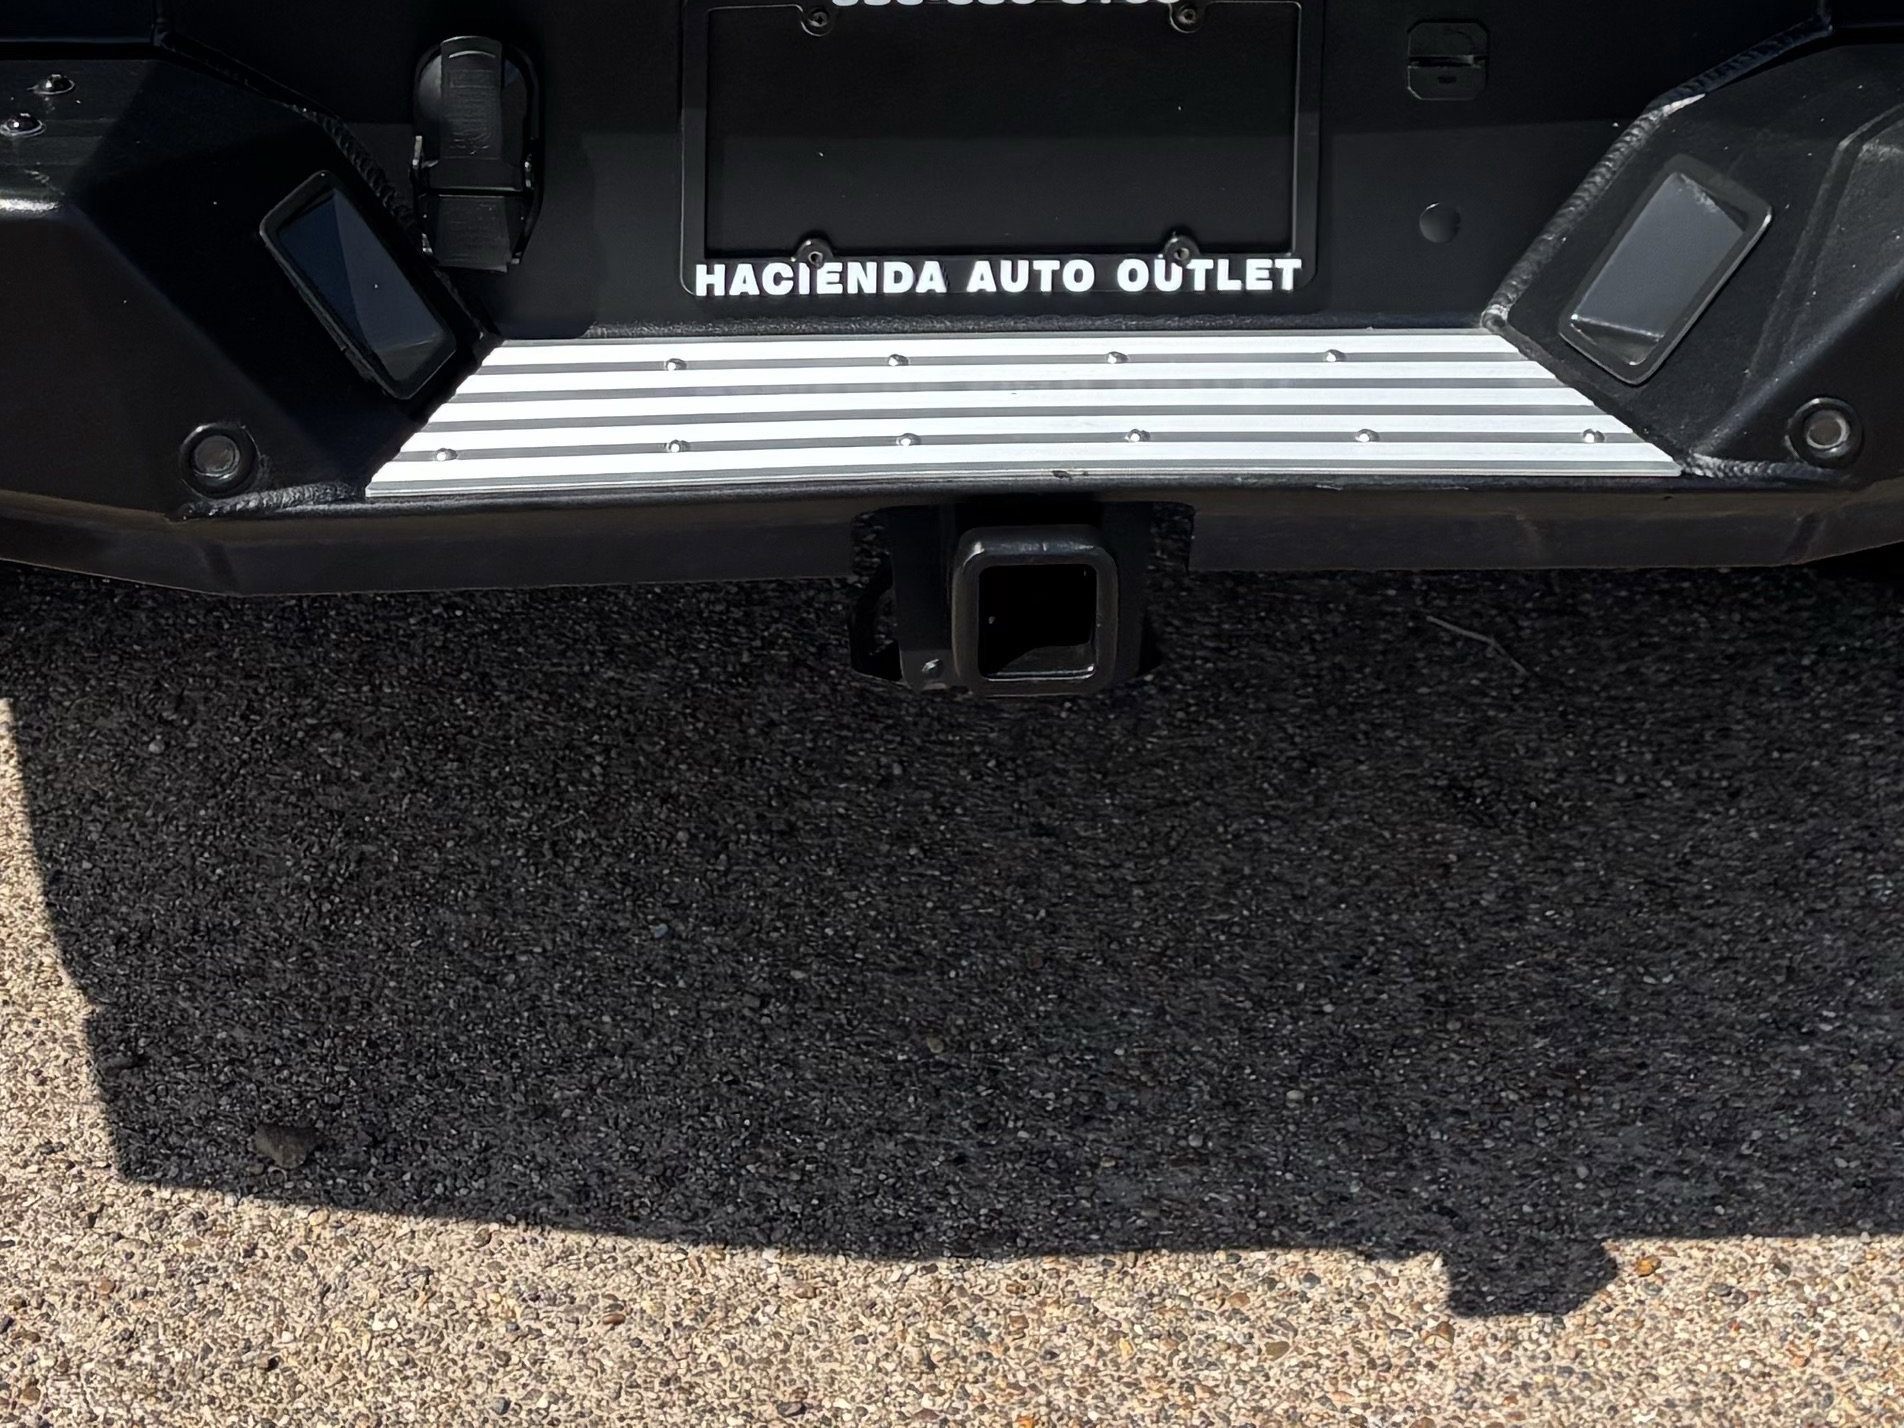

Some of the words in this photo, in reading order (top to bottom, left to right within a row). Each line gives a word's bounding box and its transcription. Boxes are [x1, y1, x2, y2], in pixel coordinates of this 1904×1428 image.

[694, 259, 948, 297] HACIENDA
[966, 259, 1096, 295] AUTO
[1116, 257, 1303, 293] OUTLET
